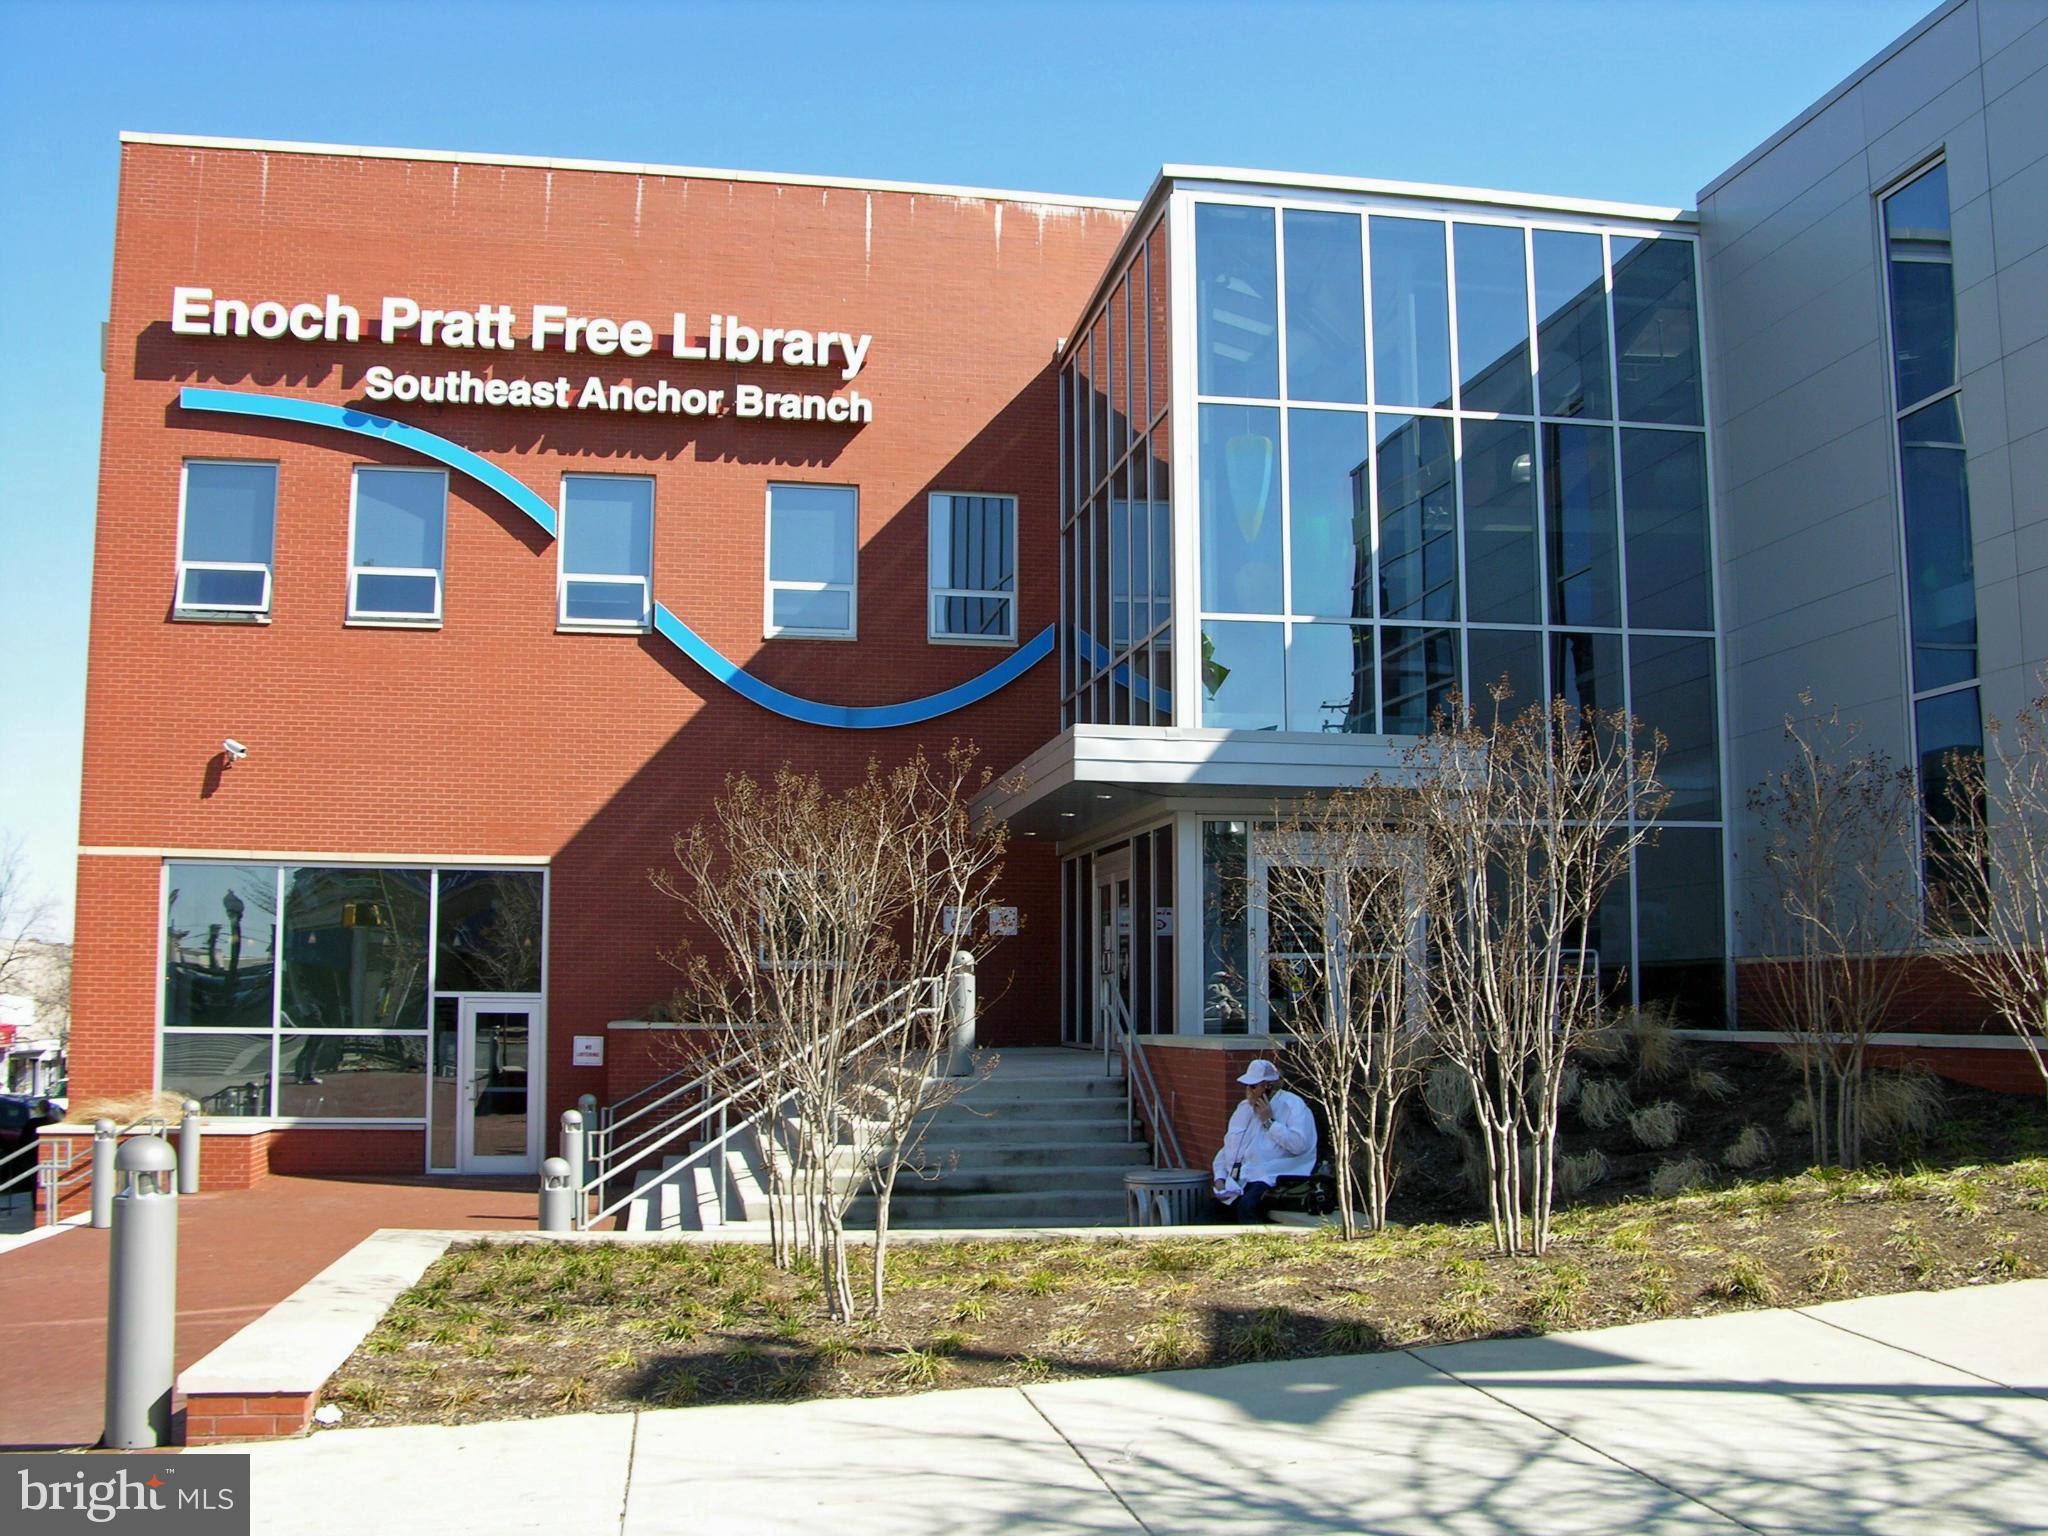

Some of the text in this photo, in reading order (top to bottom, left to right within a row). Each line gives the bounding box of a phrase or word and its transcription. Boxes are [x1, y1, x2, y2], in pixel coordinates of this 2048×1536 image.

[172, 287, 872, 381] Enoch Pratt Free Library
[365, 366, 873, 423] Southeast Anchor Branch
